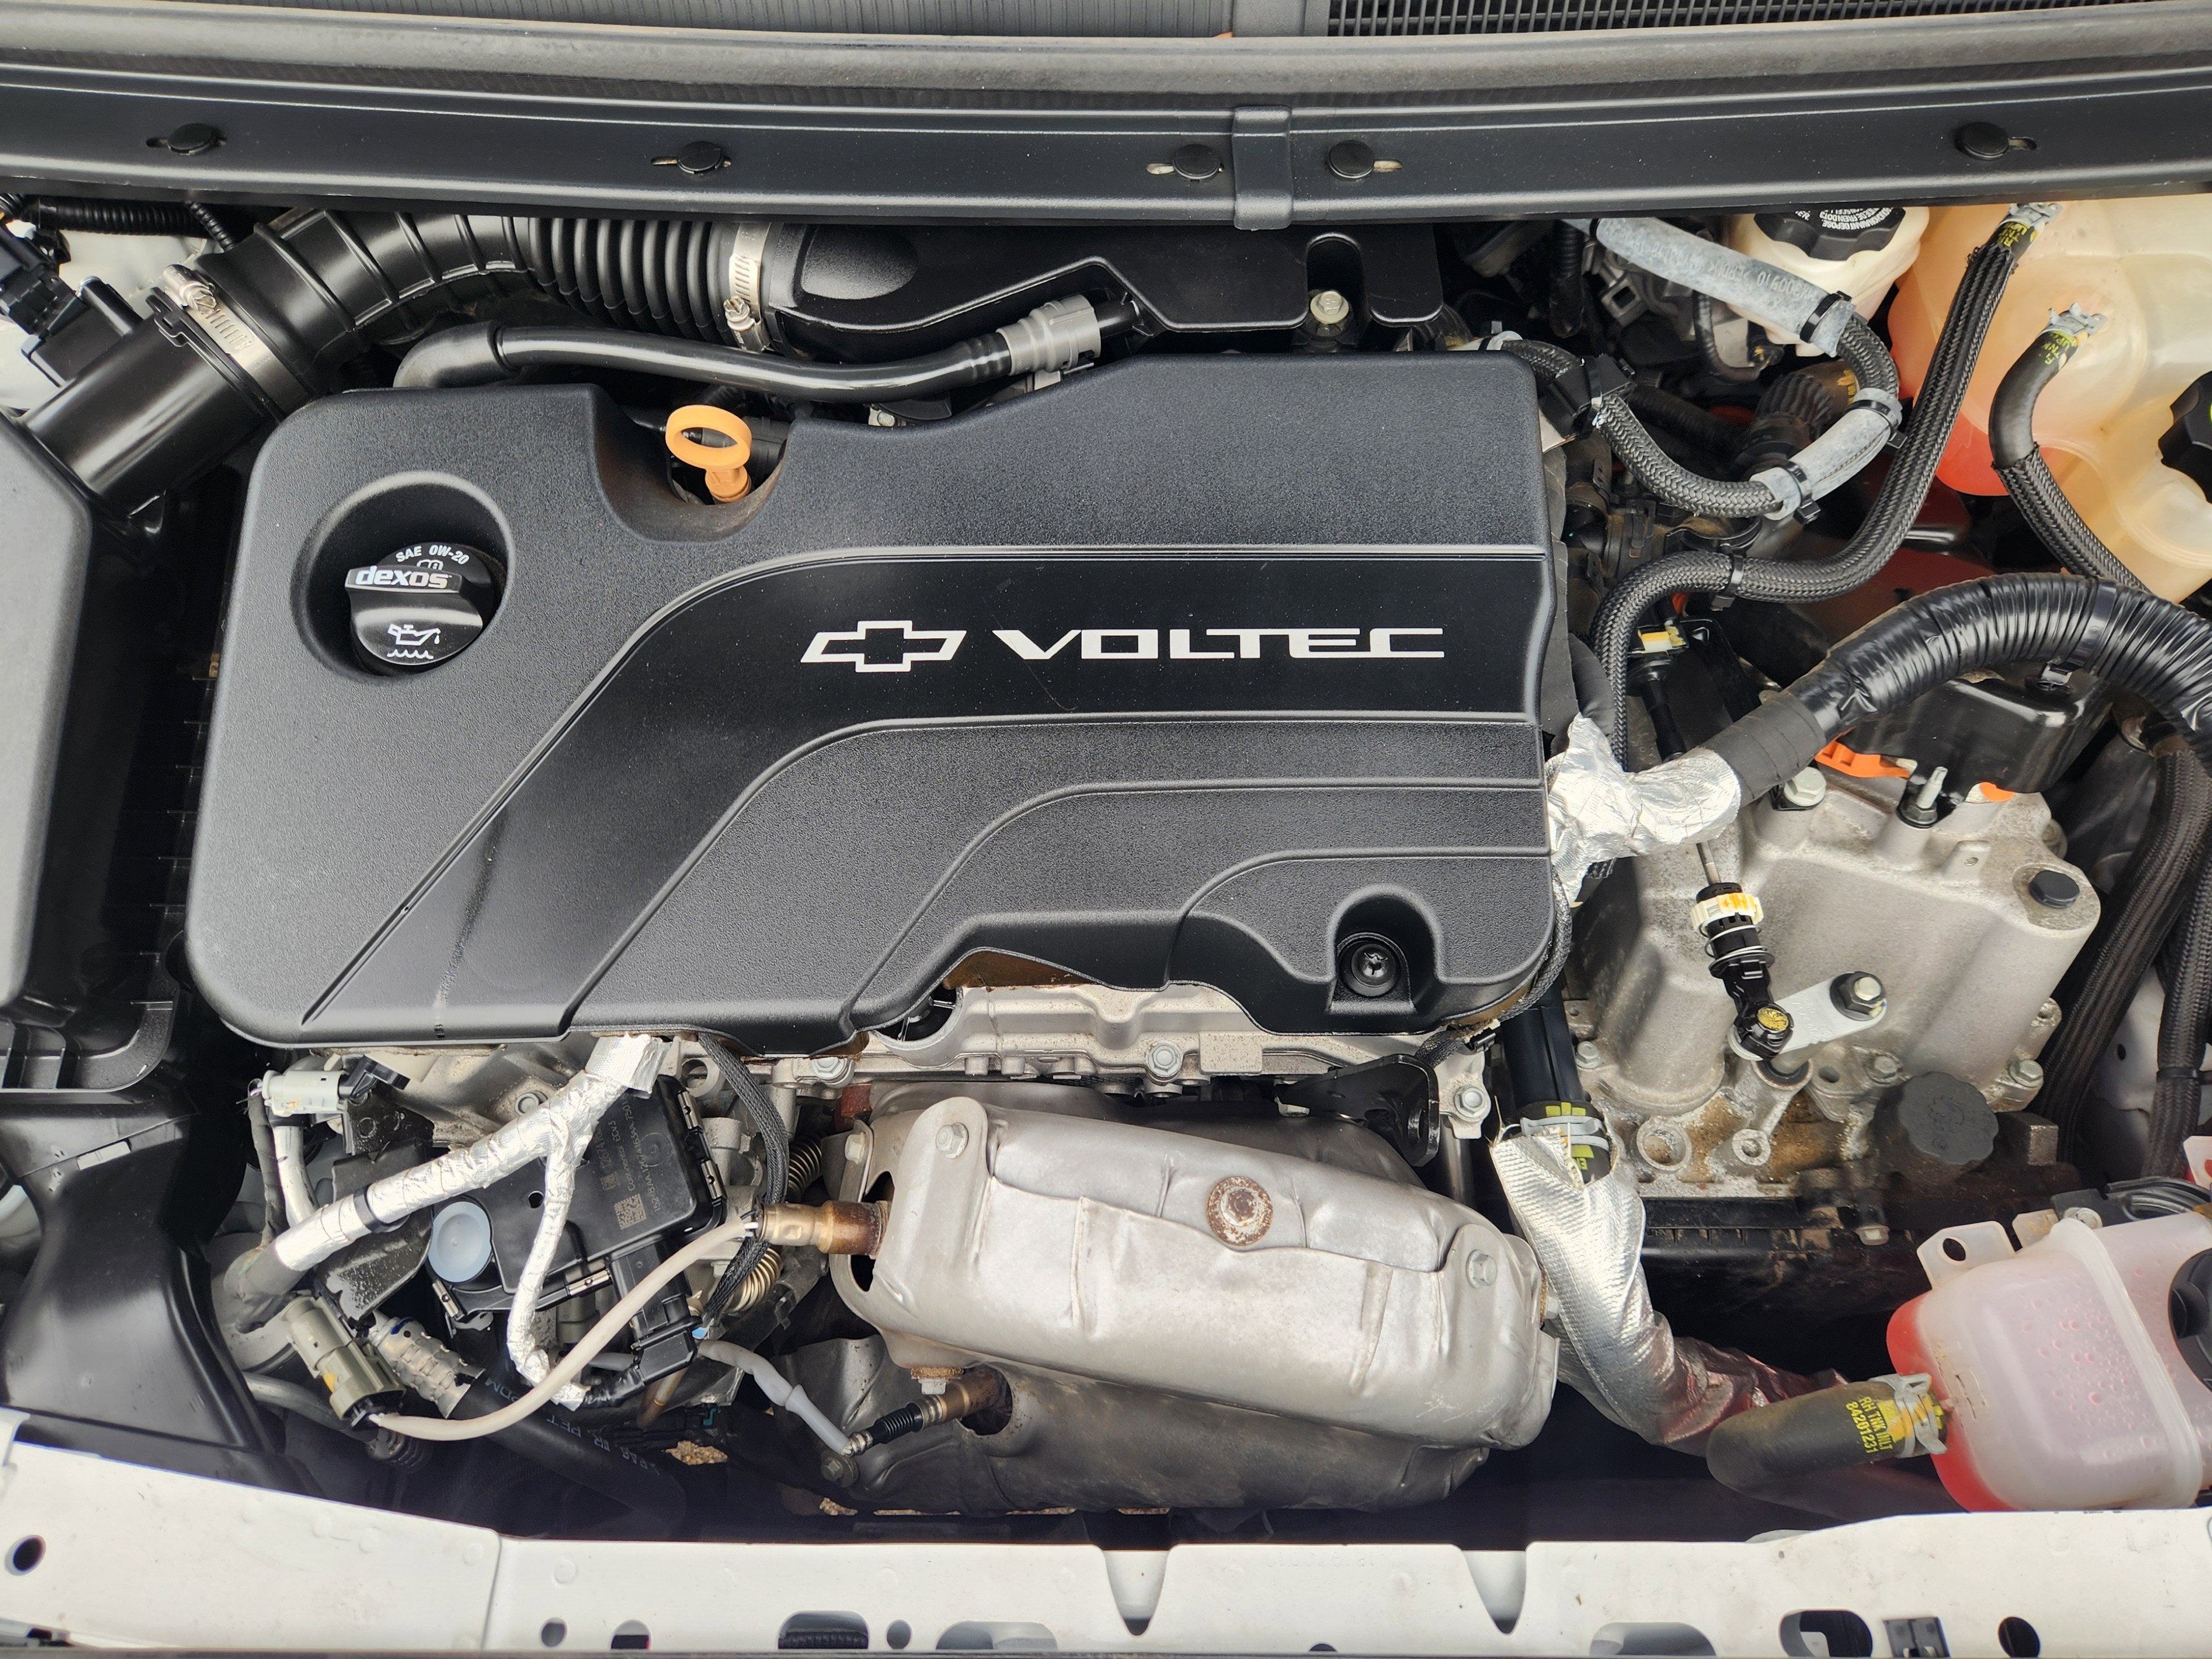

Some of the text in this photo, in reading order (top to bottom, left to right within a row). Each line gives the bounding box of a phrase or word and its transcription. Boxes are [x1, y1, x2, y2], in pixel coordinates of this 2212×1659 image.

[1819, 211, 1837, 222] DOT3
[395, 544, 469, 565] SAE 0W-20
[355, 565, 449, 589] dexos
[992, 628, 1446, 660] VOLTEC
[485, 1378, 520, 1402] PDM
[1859, 1396, 1877, 1412] RH
[546, 1415, 581, 1438] PET
[1845, 1401, 1879, 1453] 84201231
[1867, 1411, 1886, 1432] TNK
